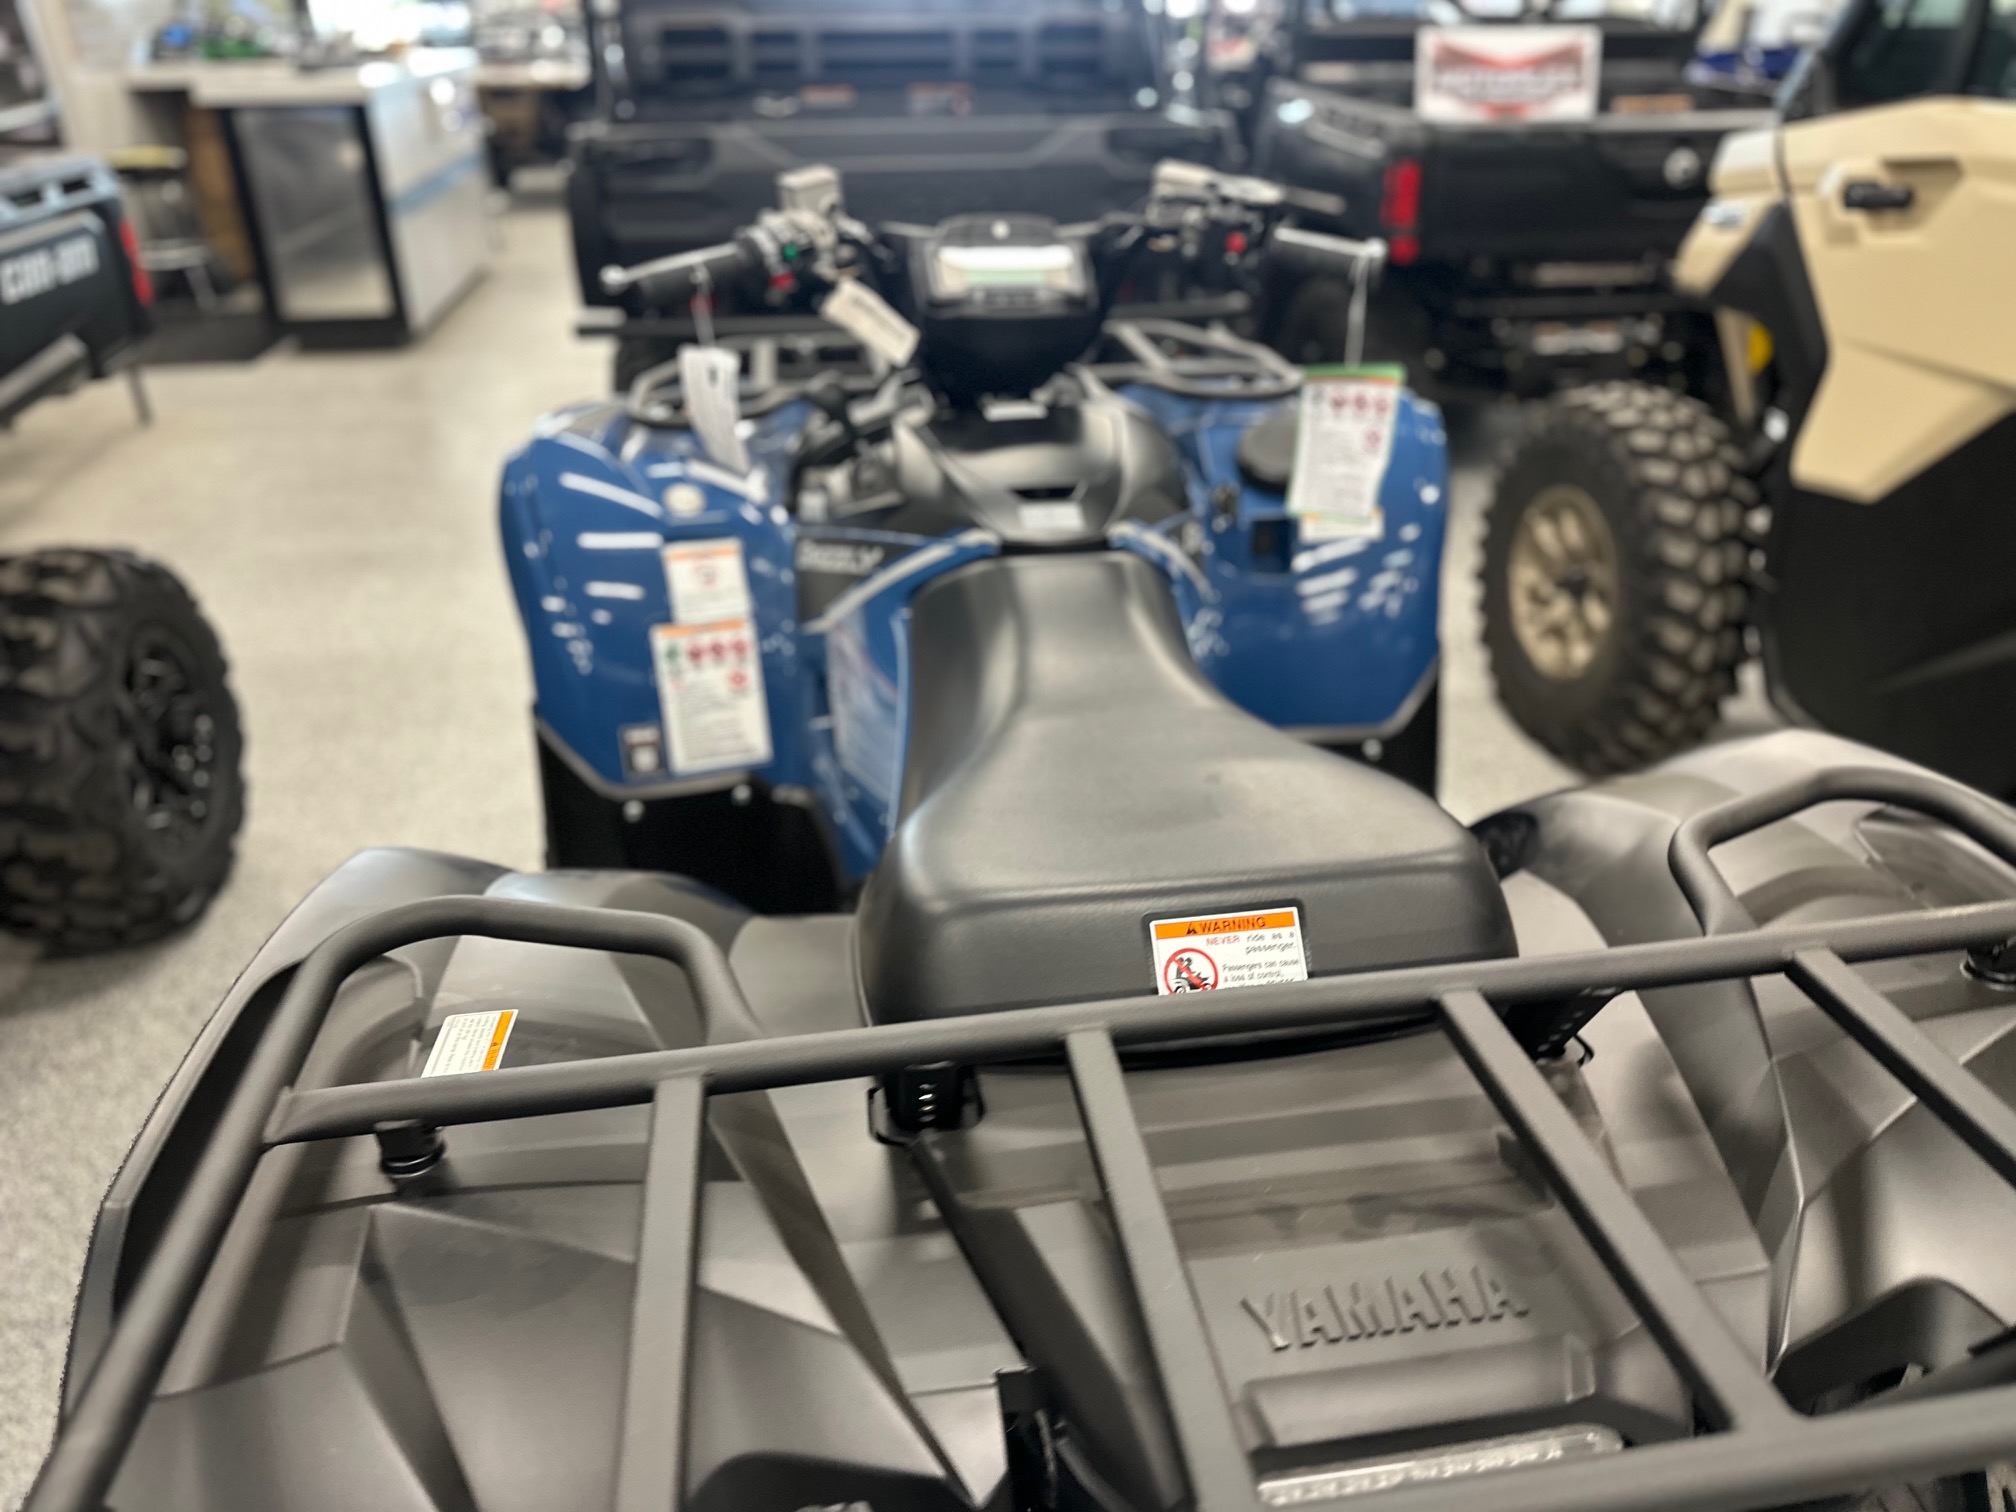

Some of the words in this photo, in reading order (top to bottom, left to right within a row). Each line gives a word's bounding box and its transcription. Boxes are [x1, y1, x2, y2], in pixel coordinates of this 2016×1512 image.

[1199, 916, 1266, 933] WARNING
[1206, 934, 1240, 946] NEVER
[1246, 932, 1265, 943] ride
[1271, 932, 1282, 940] as
[1289, 931, 1295, 939] a
[1240, 1265, 1530, 1352] YAMAHA
